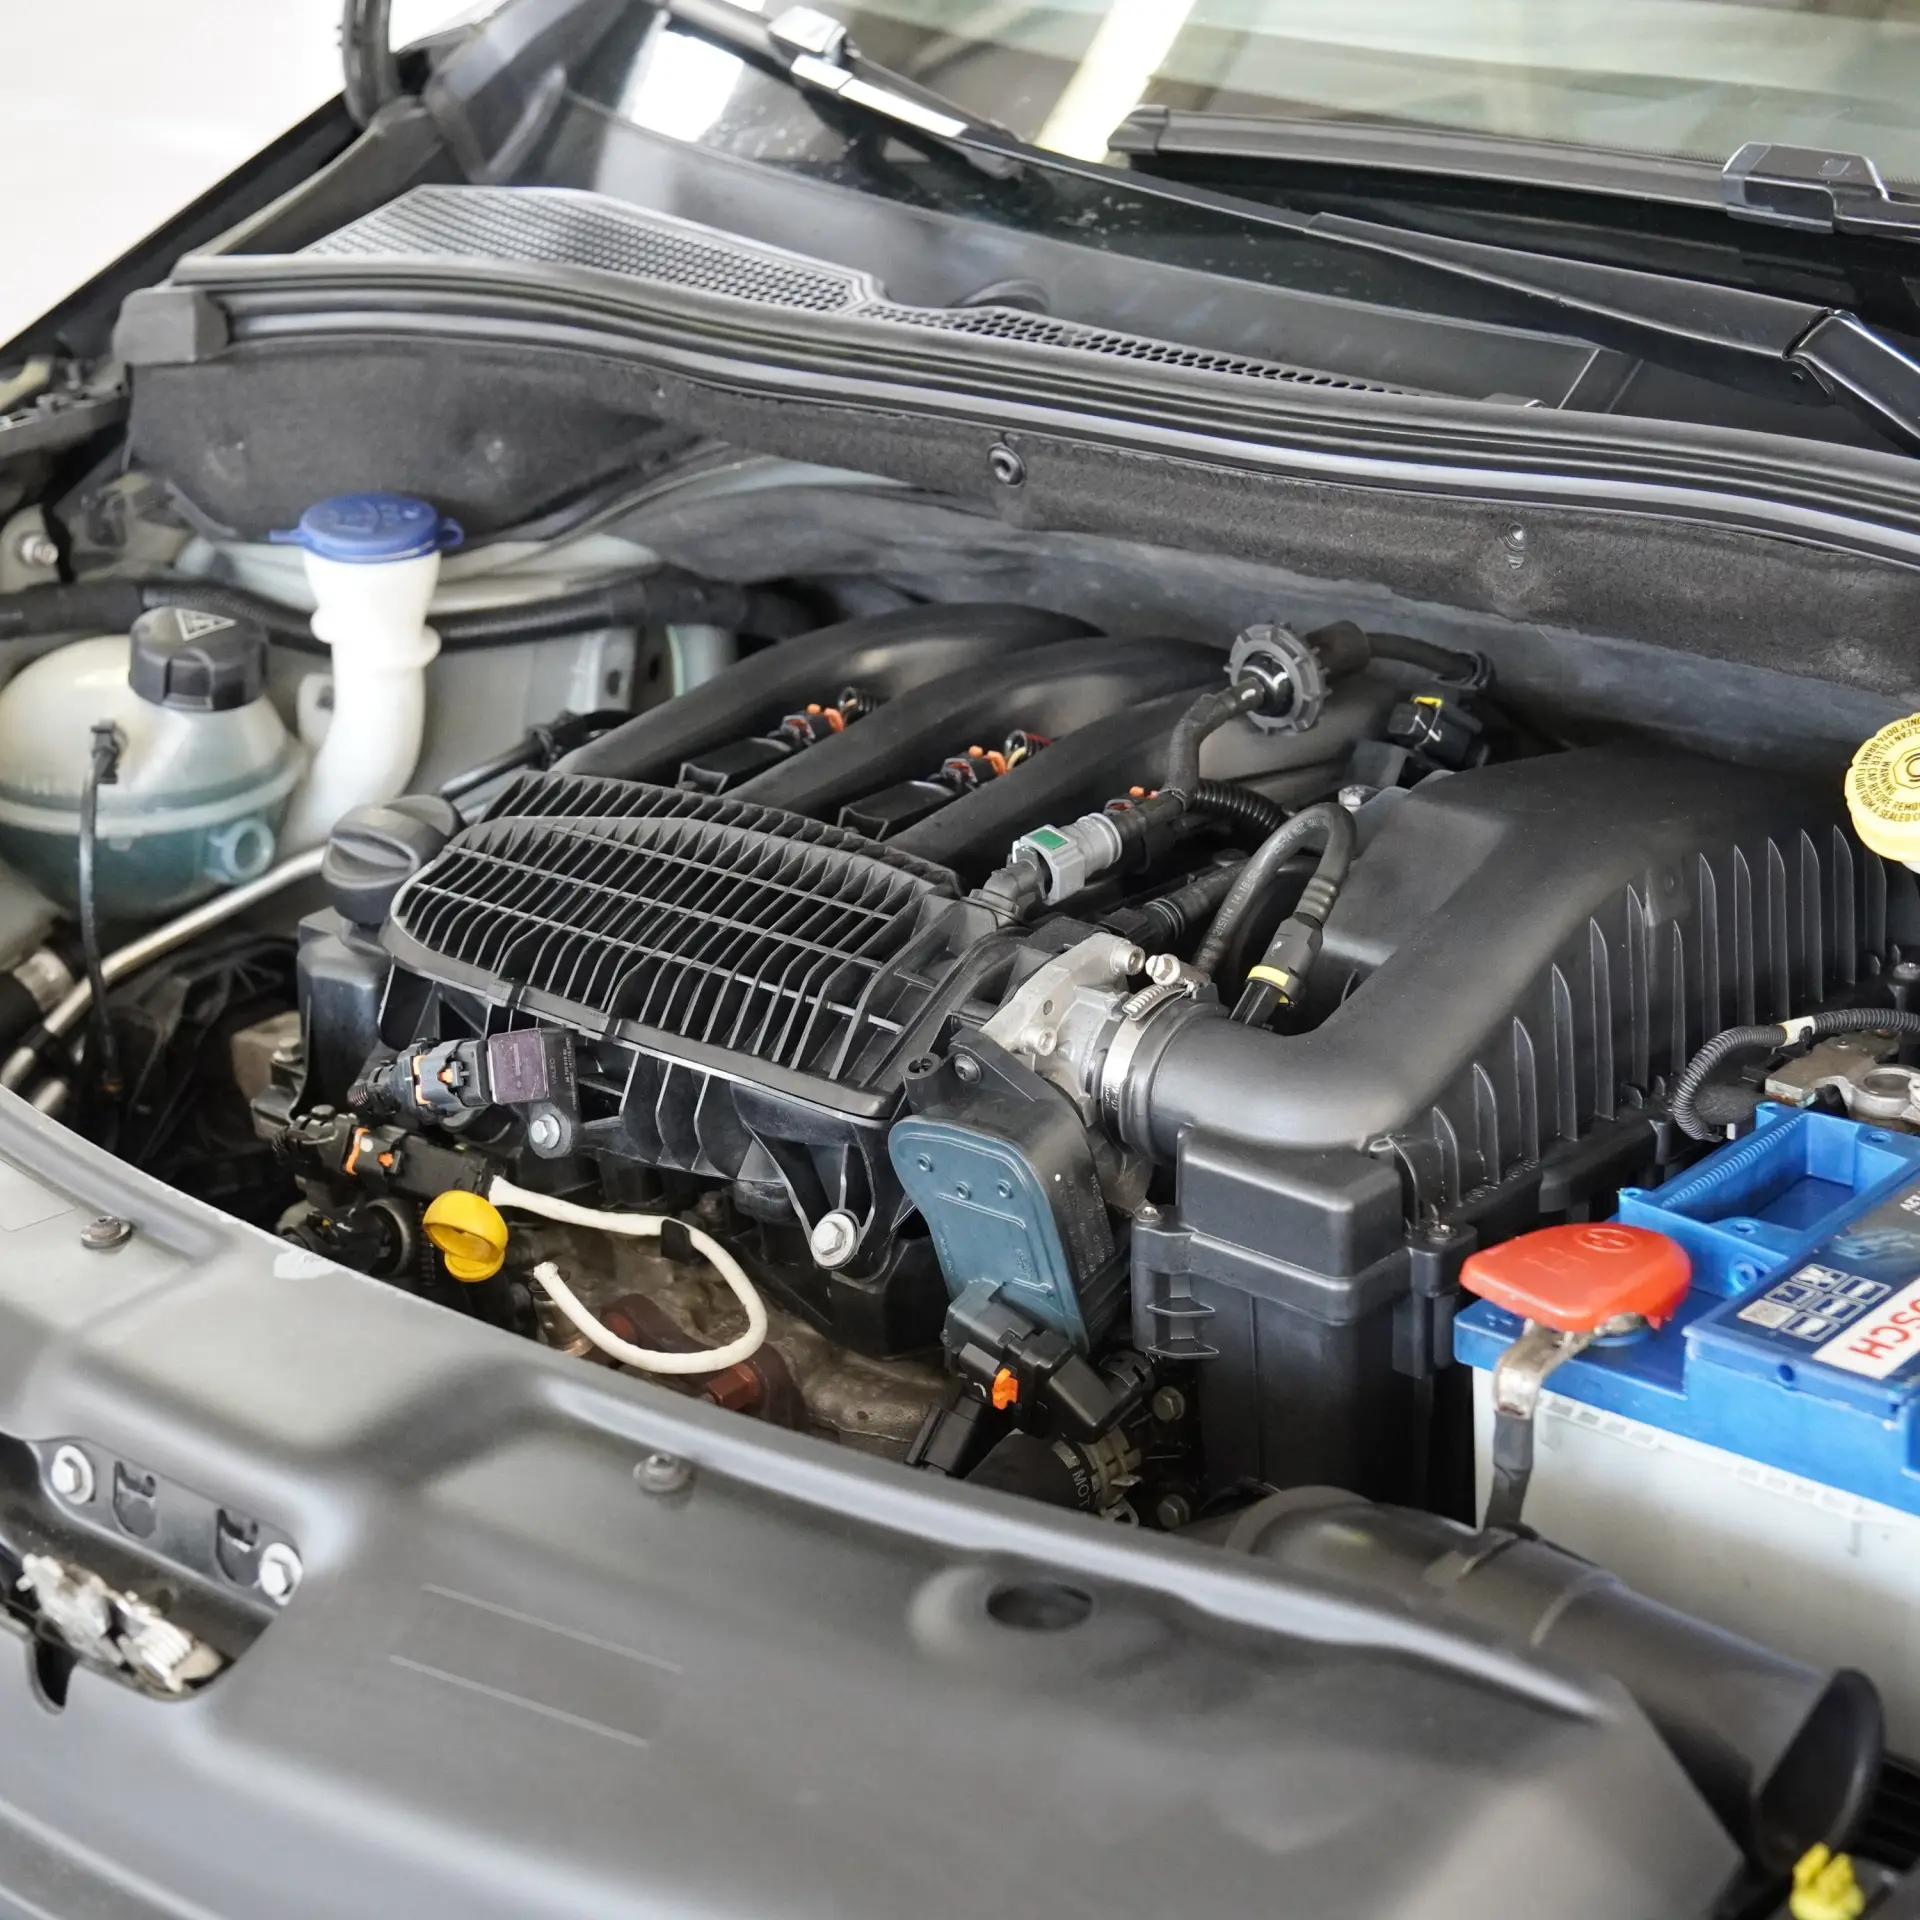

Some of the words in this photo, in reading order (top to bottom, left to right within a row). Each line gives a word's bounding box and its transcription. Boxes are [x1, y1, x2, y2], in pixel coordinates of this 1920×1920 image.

[1859, 742, 1880, 766] BRAKE
[1870, 740, 1896, 766] FILLER
[1855, 768, 1866, 790] FLUID
[1867, 767, 1878, 781] CAP
[1879, 761, 1897, 795] WARNING
[1857, 790, 1876, 811] FROM
[1868, 782, 1893, 807] BEFORE
[1892, 801, 1920, 811] REMO
[1878, 809, 1911, 822] SEALED
[549, 1058, 557, 1084] VALEO
[1848, 1298, 1920, 1359] SCH
